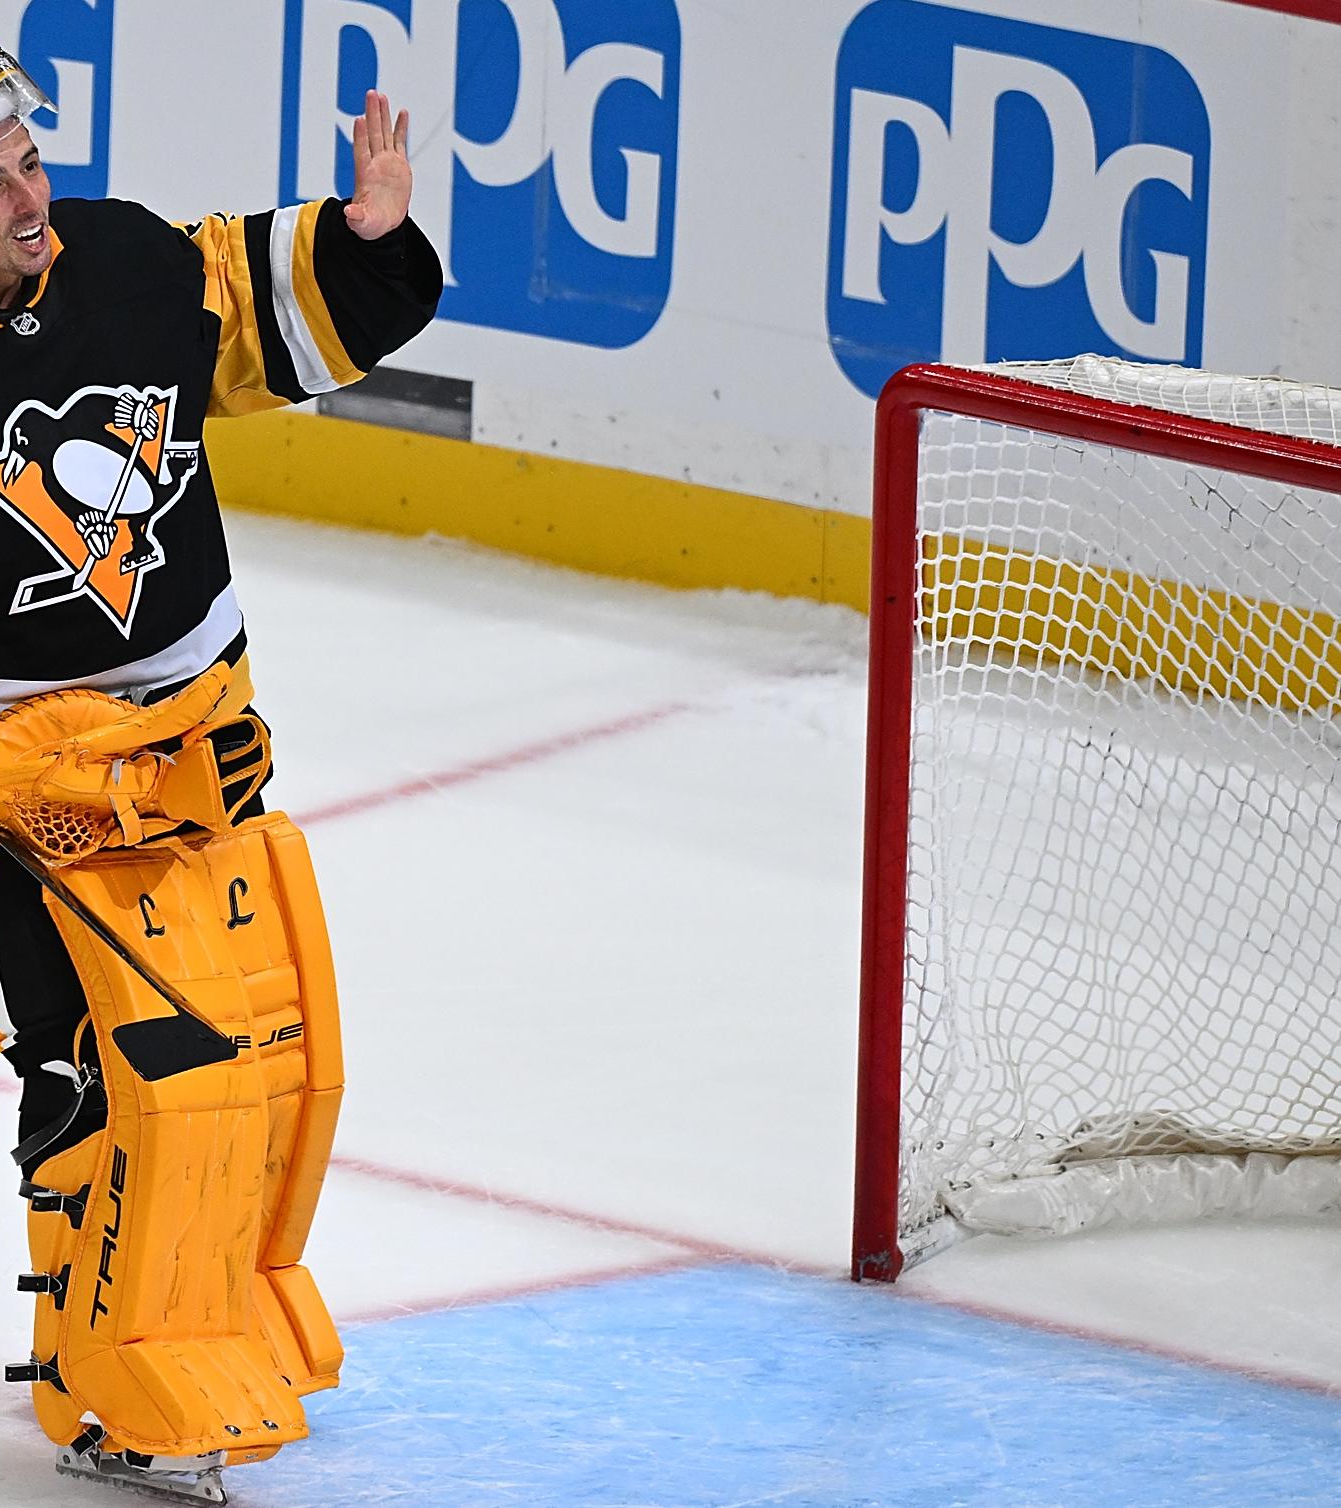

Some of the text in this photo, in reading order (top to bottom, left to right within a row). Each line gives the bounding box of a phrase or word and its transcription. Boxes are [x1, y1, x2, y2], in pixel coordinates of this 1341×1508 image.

[296, 0, 663, 287] PPG
[842, 45, 1193, 363] PPG
[90, 1145, 127, 1331] TRUE
